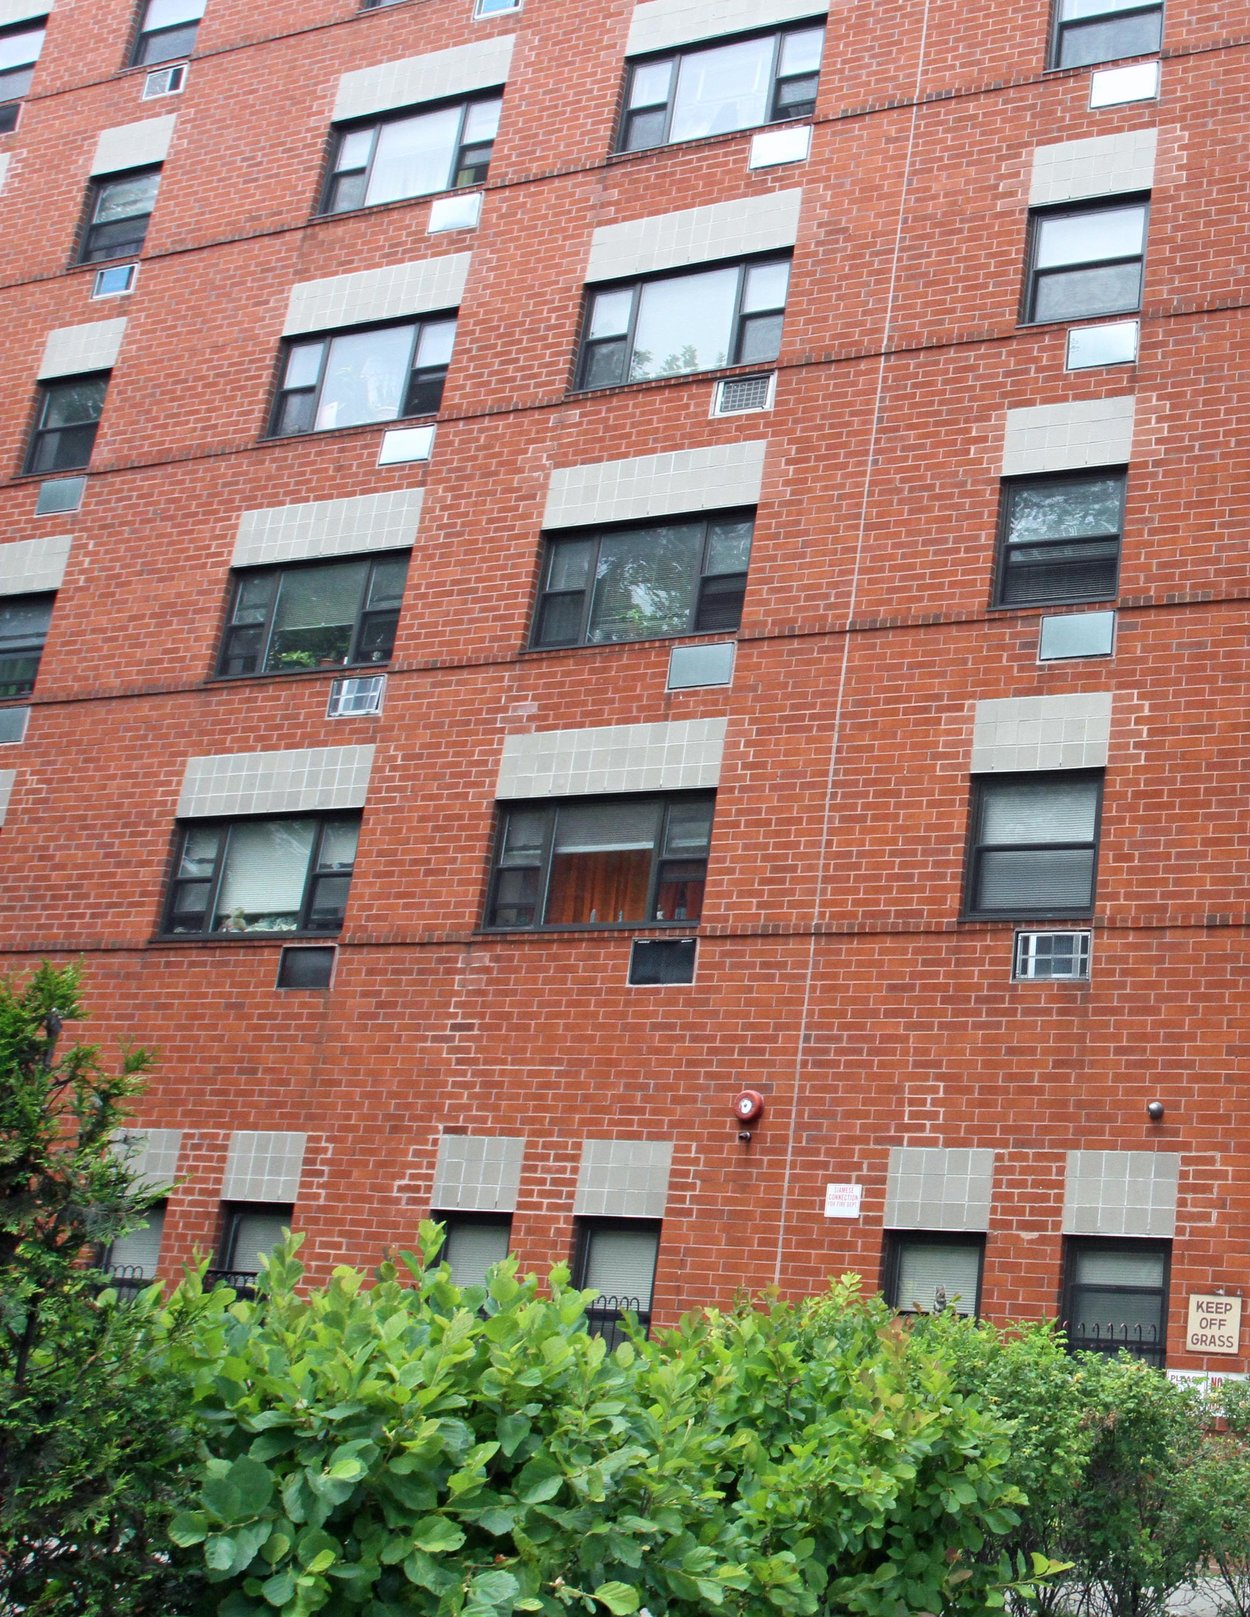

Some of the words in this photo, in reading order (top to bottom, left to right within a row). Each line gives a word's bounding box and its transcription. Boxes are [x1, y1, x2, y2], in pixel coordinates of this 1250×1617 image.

[1196, 1300, 1233, 1315] KEEP
[1199, 1317, 1227, 1331] OFF
[1191, 1333, 1234, 1348] GRASS
